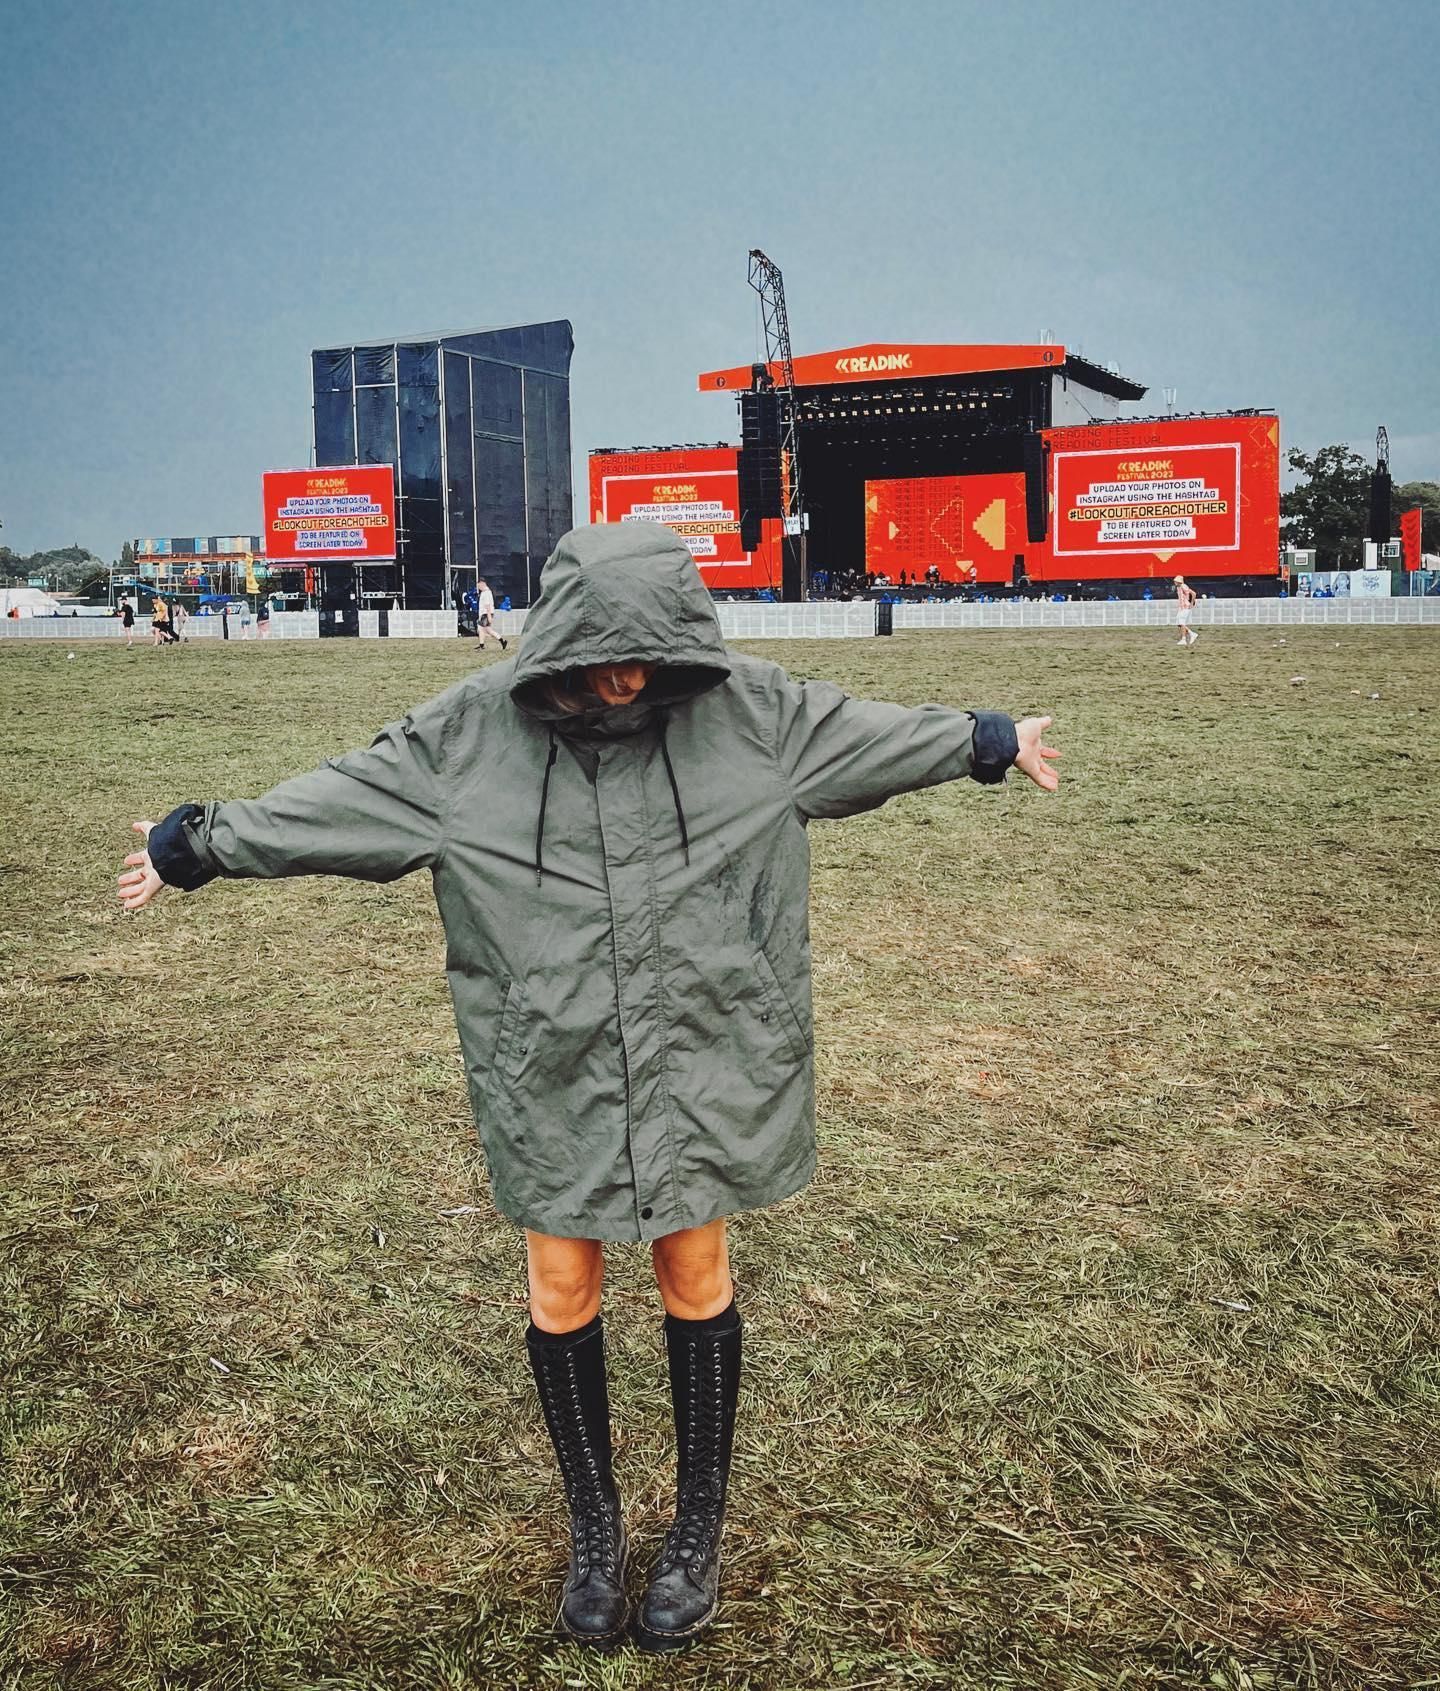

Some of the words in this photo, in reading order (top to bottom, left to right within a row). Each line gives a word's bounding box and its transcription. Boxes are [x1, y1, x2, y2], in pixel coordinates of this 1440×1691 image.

[850, 353, 913, 373] READING
[1053, 429, 1101, 438] READING
[1109, 427, 1129, 436] FES
[1053, 439, 1101, 448] READING
[1109, 436, 1162, 447] FESTIVAL
[601, 455, 640, 464] READING
[645, 454, 661, 463] FES
[601, 465, 640, 473] READING
[645, 463, 689, 472] FESTIVAL
[1129, 460, 1174, 472] READING
[1093, 484, 1126, 493] UPLOAD
[1129, 483, 1150, 491] YOUR
[1152, 481, 1186, 490] PHOTOS
[289, 498, 314, 506] UPLOAD
[315, 497, 331, 505] YOUR
[332, 497, 358, 505] PHOTOS
[1079, 495, 1125, 504] INSTAGRAM
[1128, 494, 1154, 502] USING
[1175, 491, 1216, 500] HASHTAG
[280, 507, 315, 516] INSTAGRAM
[336, 506, 348, 514] THE
[349, 505, 380, 513] HASHTAG
[634, 505, 660, 513] UPLOAD
[680, 503, 708, 511] PHOTOS
[1069, 503, 1226, 520] #LOOKOUTFOREACHOTHER
[699, 511, 732, 520] HASHTAG
[273, 516, 388, 530] #LOOKOUTFOREACHOTHER
[1106, 522, 1117, 530] TO
[1119, 521, 1129, 529] BE
[1131, 519, 1171, 528] FEATURED
[1103, 532, 1135, 540] SCREEN
[1163, 529, 1190, 537] TODAY
[342, 539, 363, 547] TODAY
[690, 546, 713, 554] TODAY
